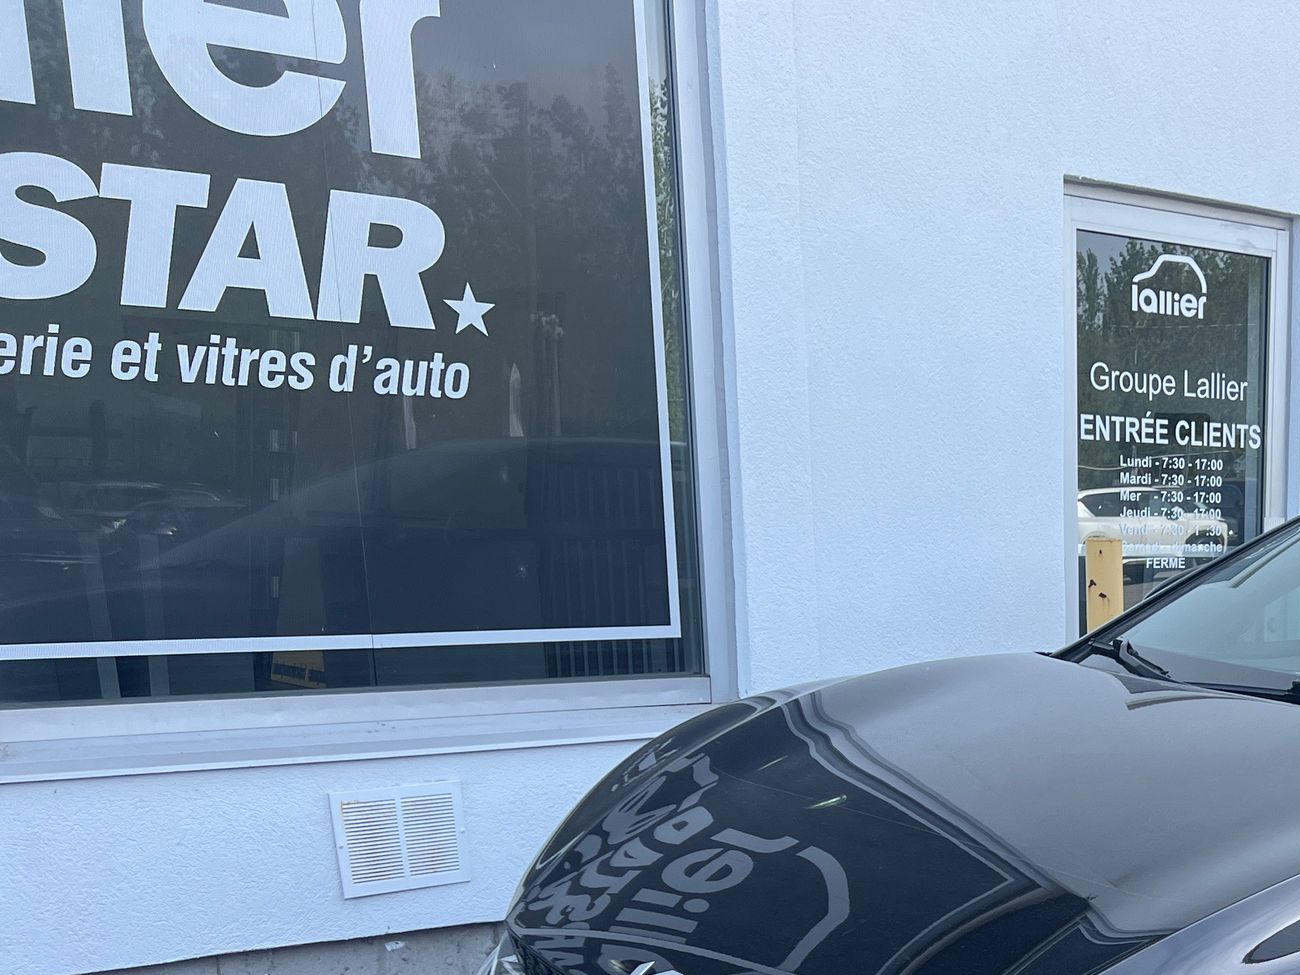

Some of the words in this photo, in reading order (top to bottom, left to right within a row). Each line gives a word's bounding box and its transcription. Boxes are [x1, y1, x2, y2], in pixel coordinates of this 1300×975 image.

[1132, 284, 1206, 319] lallier
[111, 332, 162, 382] et
[177, 334, 316, 389] vitres
[329, 344, 470, 399] d'auto
[1090, 361, 1176, 401] Groupe
[1184, 369, 1248, 401] Lallier
[1080, 411, 1169, 445] ENTRÉE
[1175, 420, 1262, 449] CLIENTS
[1120, 454, 1152, 468] Lundi
[1162, 457, 1185, 469] 7:30
[1195, 458, 1223, 471] 17:00
[1120, 472, 1152, 485] Mardi
[1161, 474, 1184, 486] 7:30
[1194, 475, 1222, 487] 17:00
[1120, 489, 1141, 501] Mer
[1160, 490, 1184, 503] 7:30
[1193, 492, 1222, 504] 17:00
[1120, 506, 1151, 518] Jeudi
[1160, 508, 1184, 520] 7:30
[1195, 525, 1222, 537] 1:30
